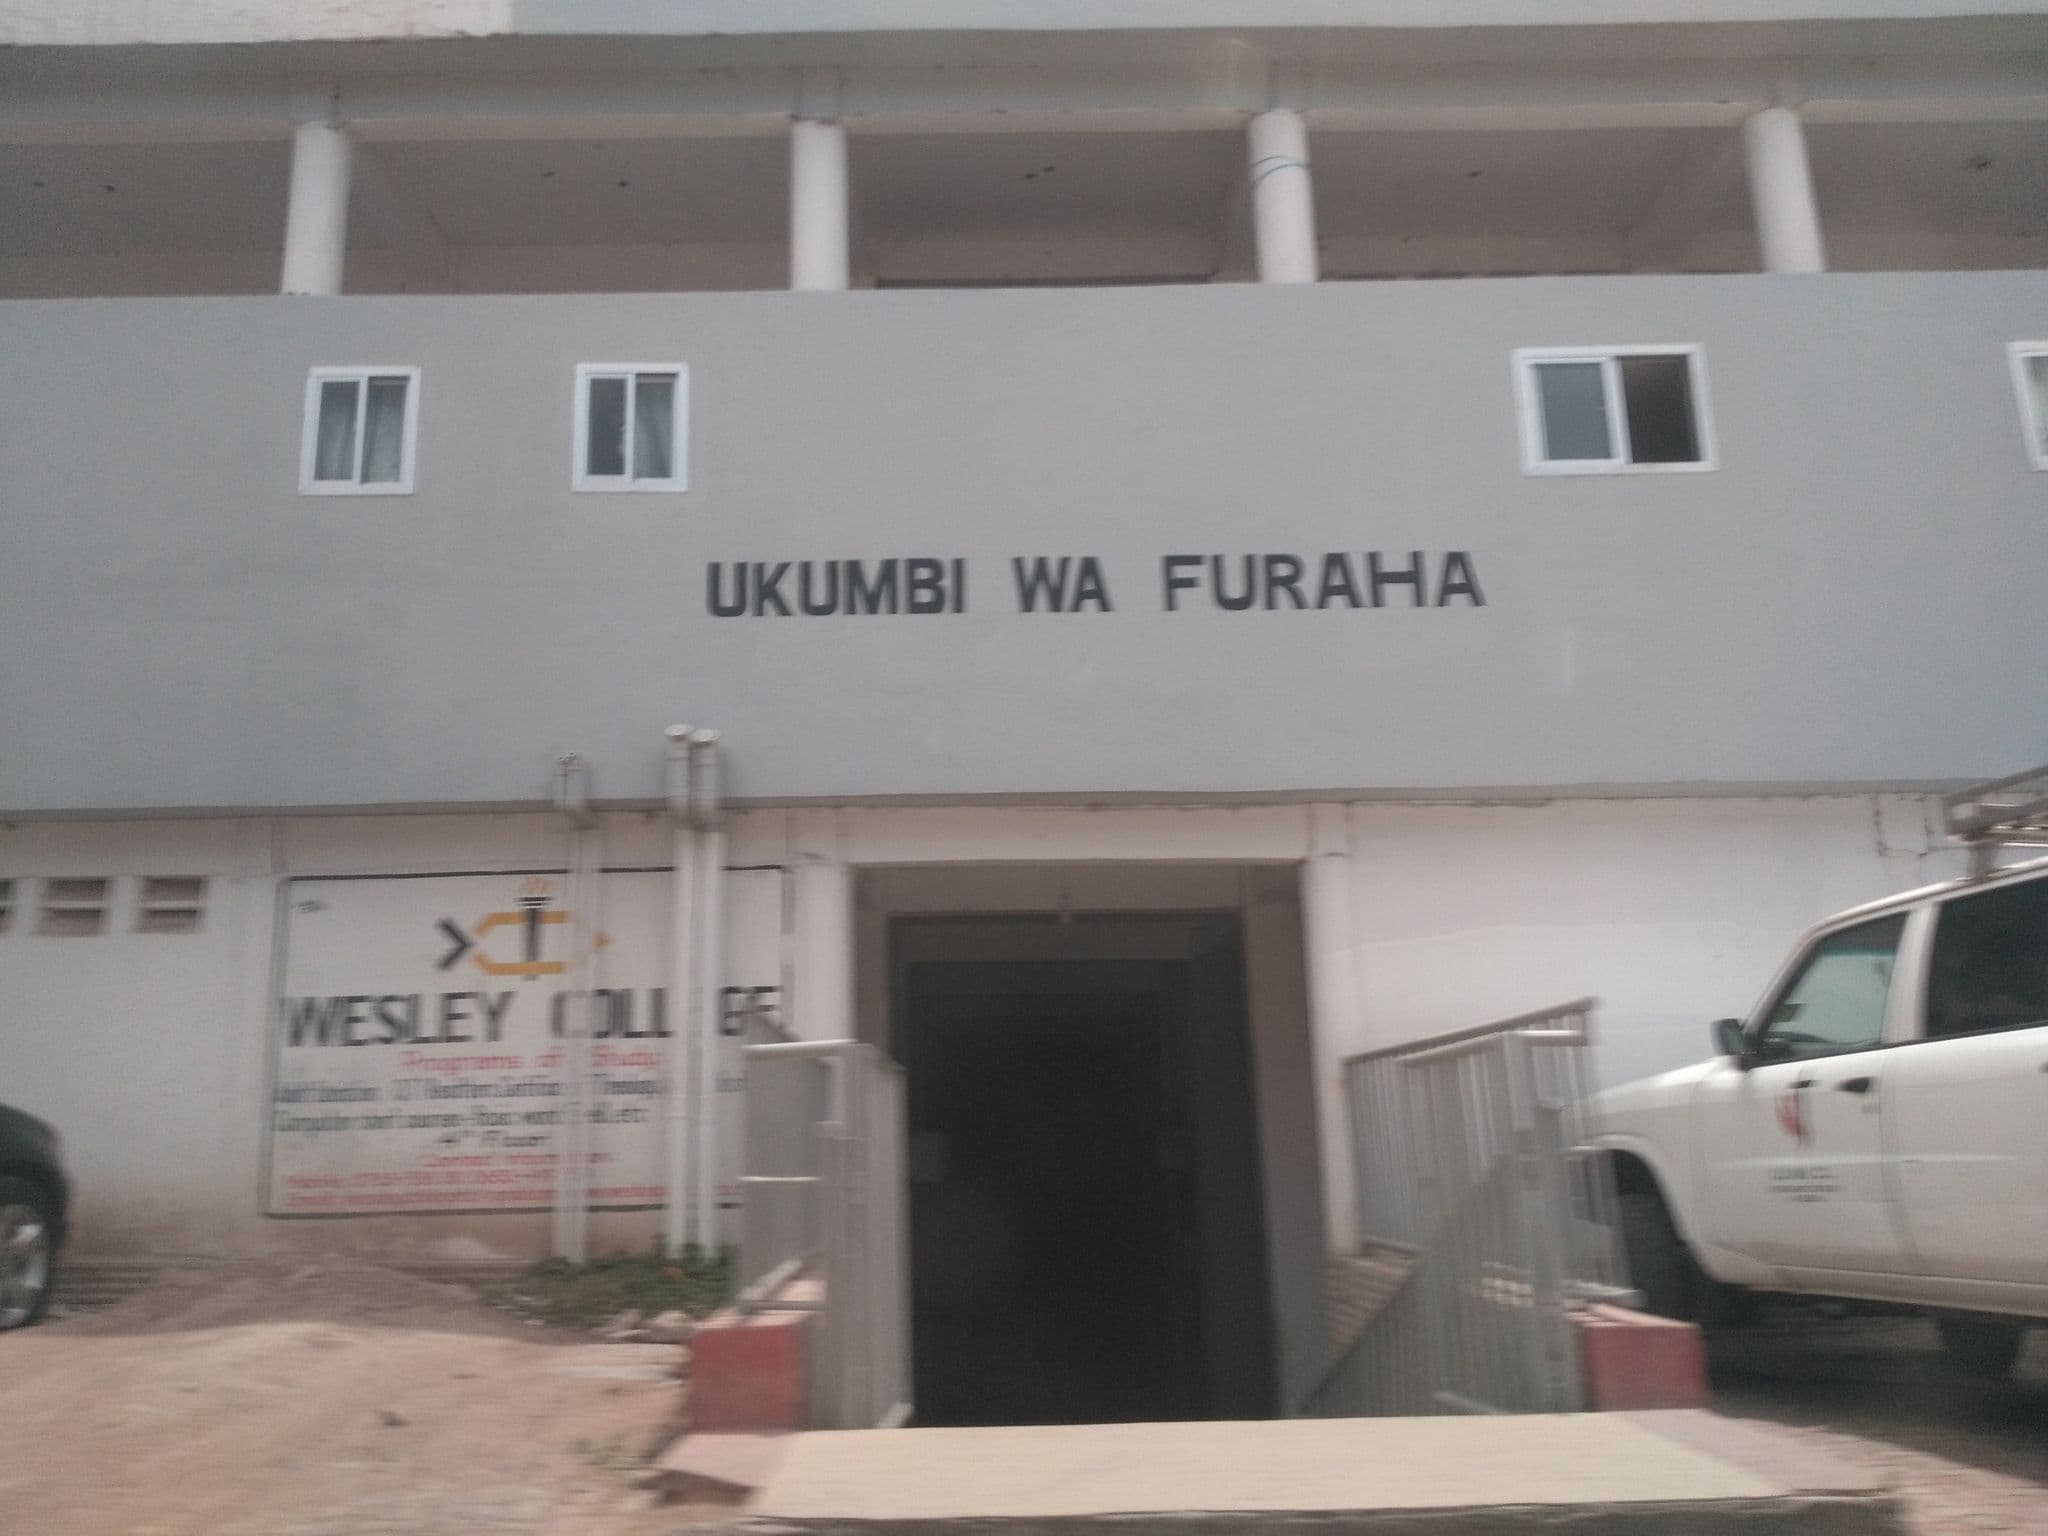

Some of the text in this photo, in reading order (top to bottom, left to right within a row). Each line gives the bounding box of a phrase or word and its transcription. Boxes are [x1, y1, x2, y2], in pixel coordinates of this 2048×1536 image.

[706, 549, 1486, 618] UKUMBI WA FURAHA
[284, 985, 784, 1047] WESLEY COLLGE
